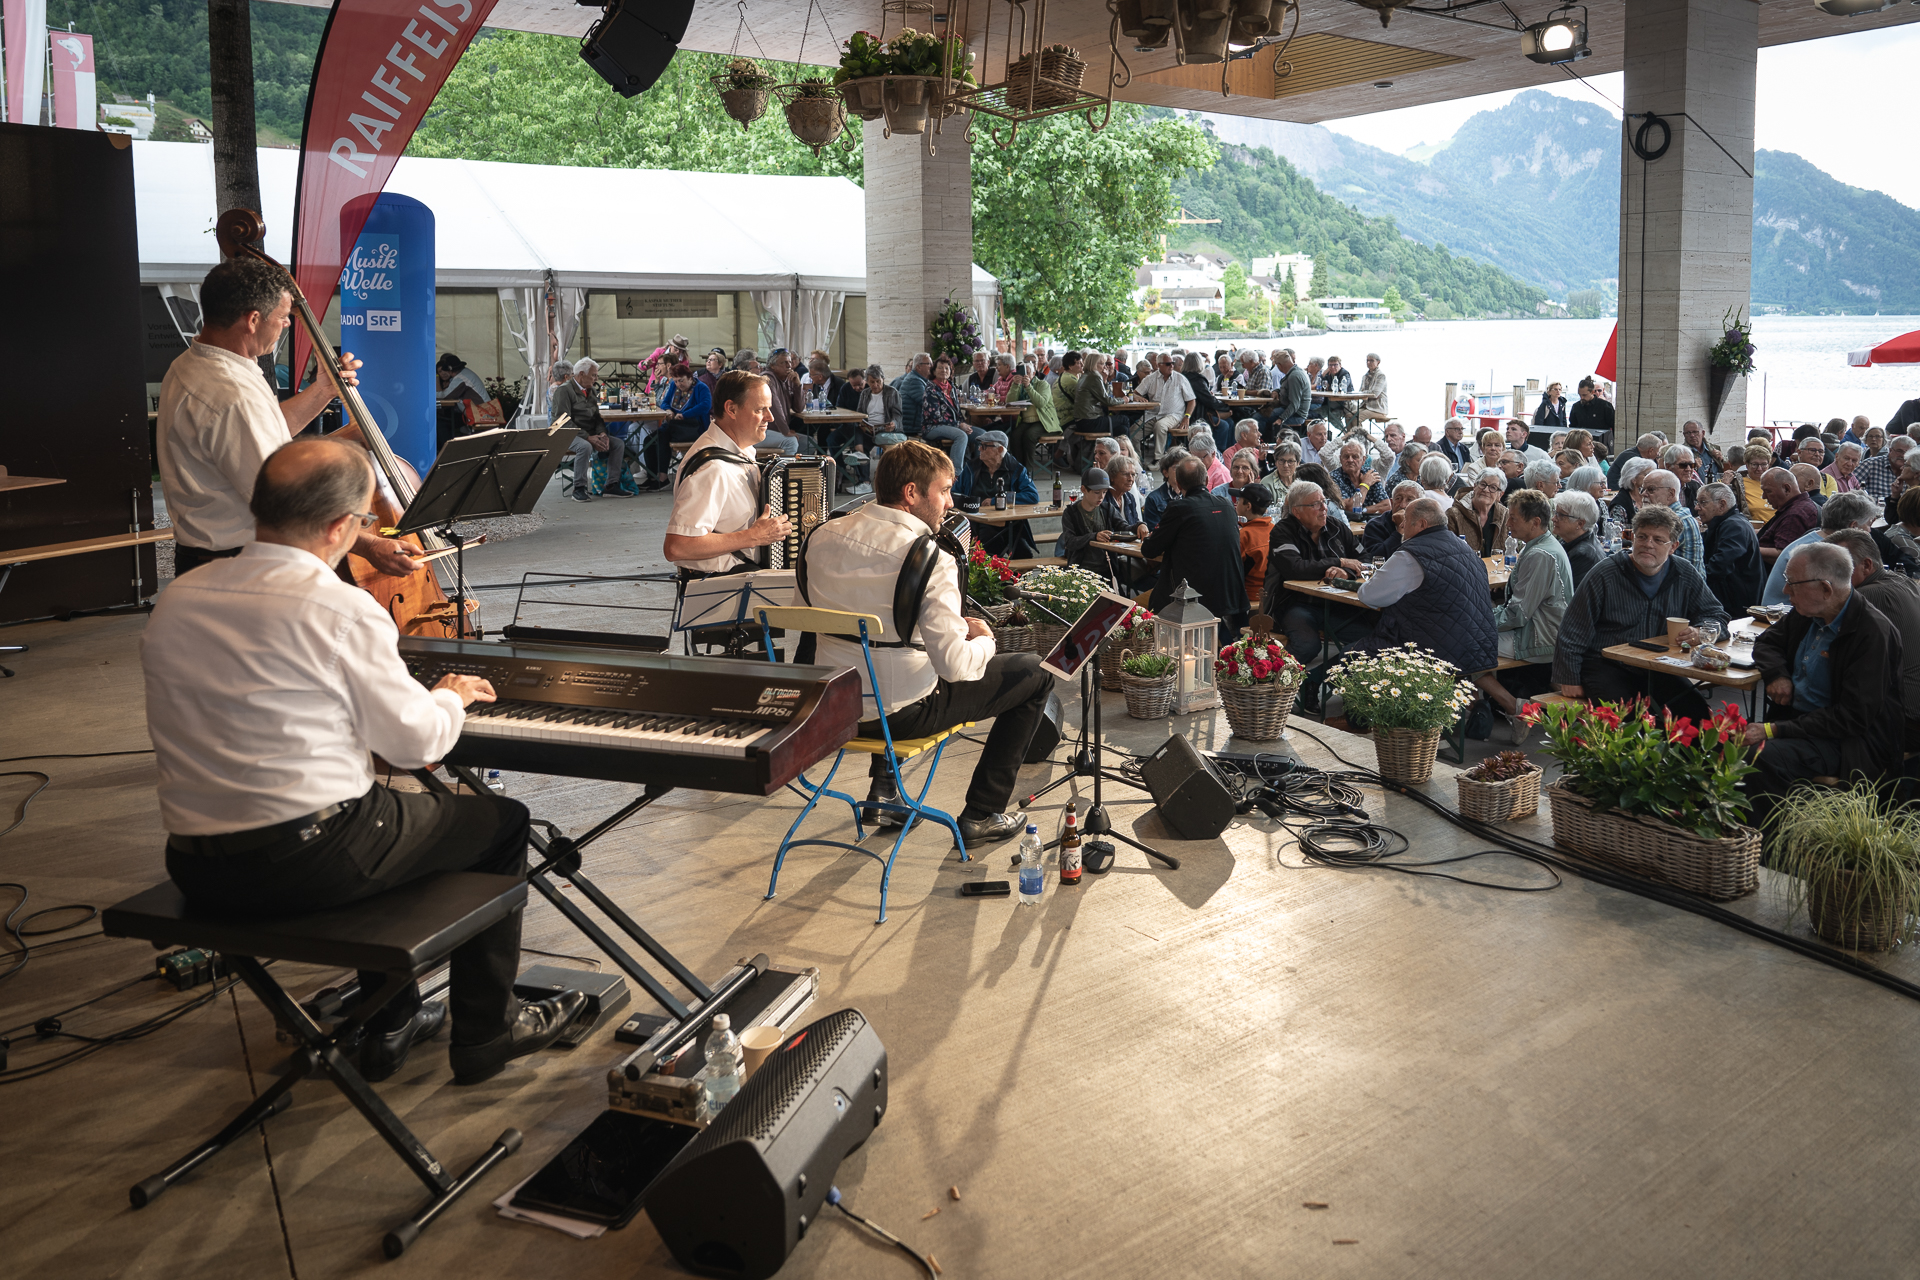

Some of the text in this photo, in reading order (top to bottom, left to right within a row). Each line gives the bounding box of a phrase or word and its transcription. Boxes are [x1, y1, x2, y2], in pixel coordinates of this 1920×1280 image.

[346, 243, 398, 271] Musik
[341, 267, 393, 300] Welle
[370, 315, 397, 326] SRF
